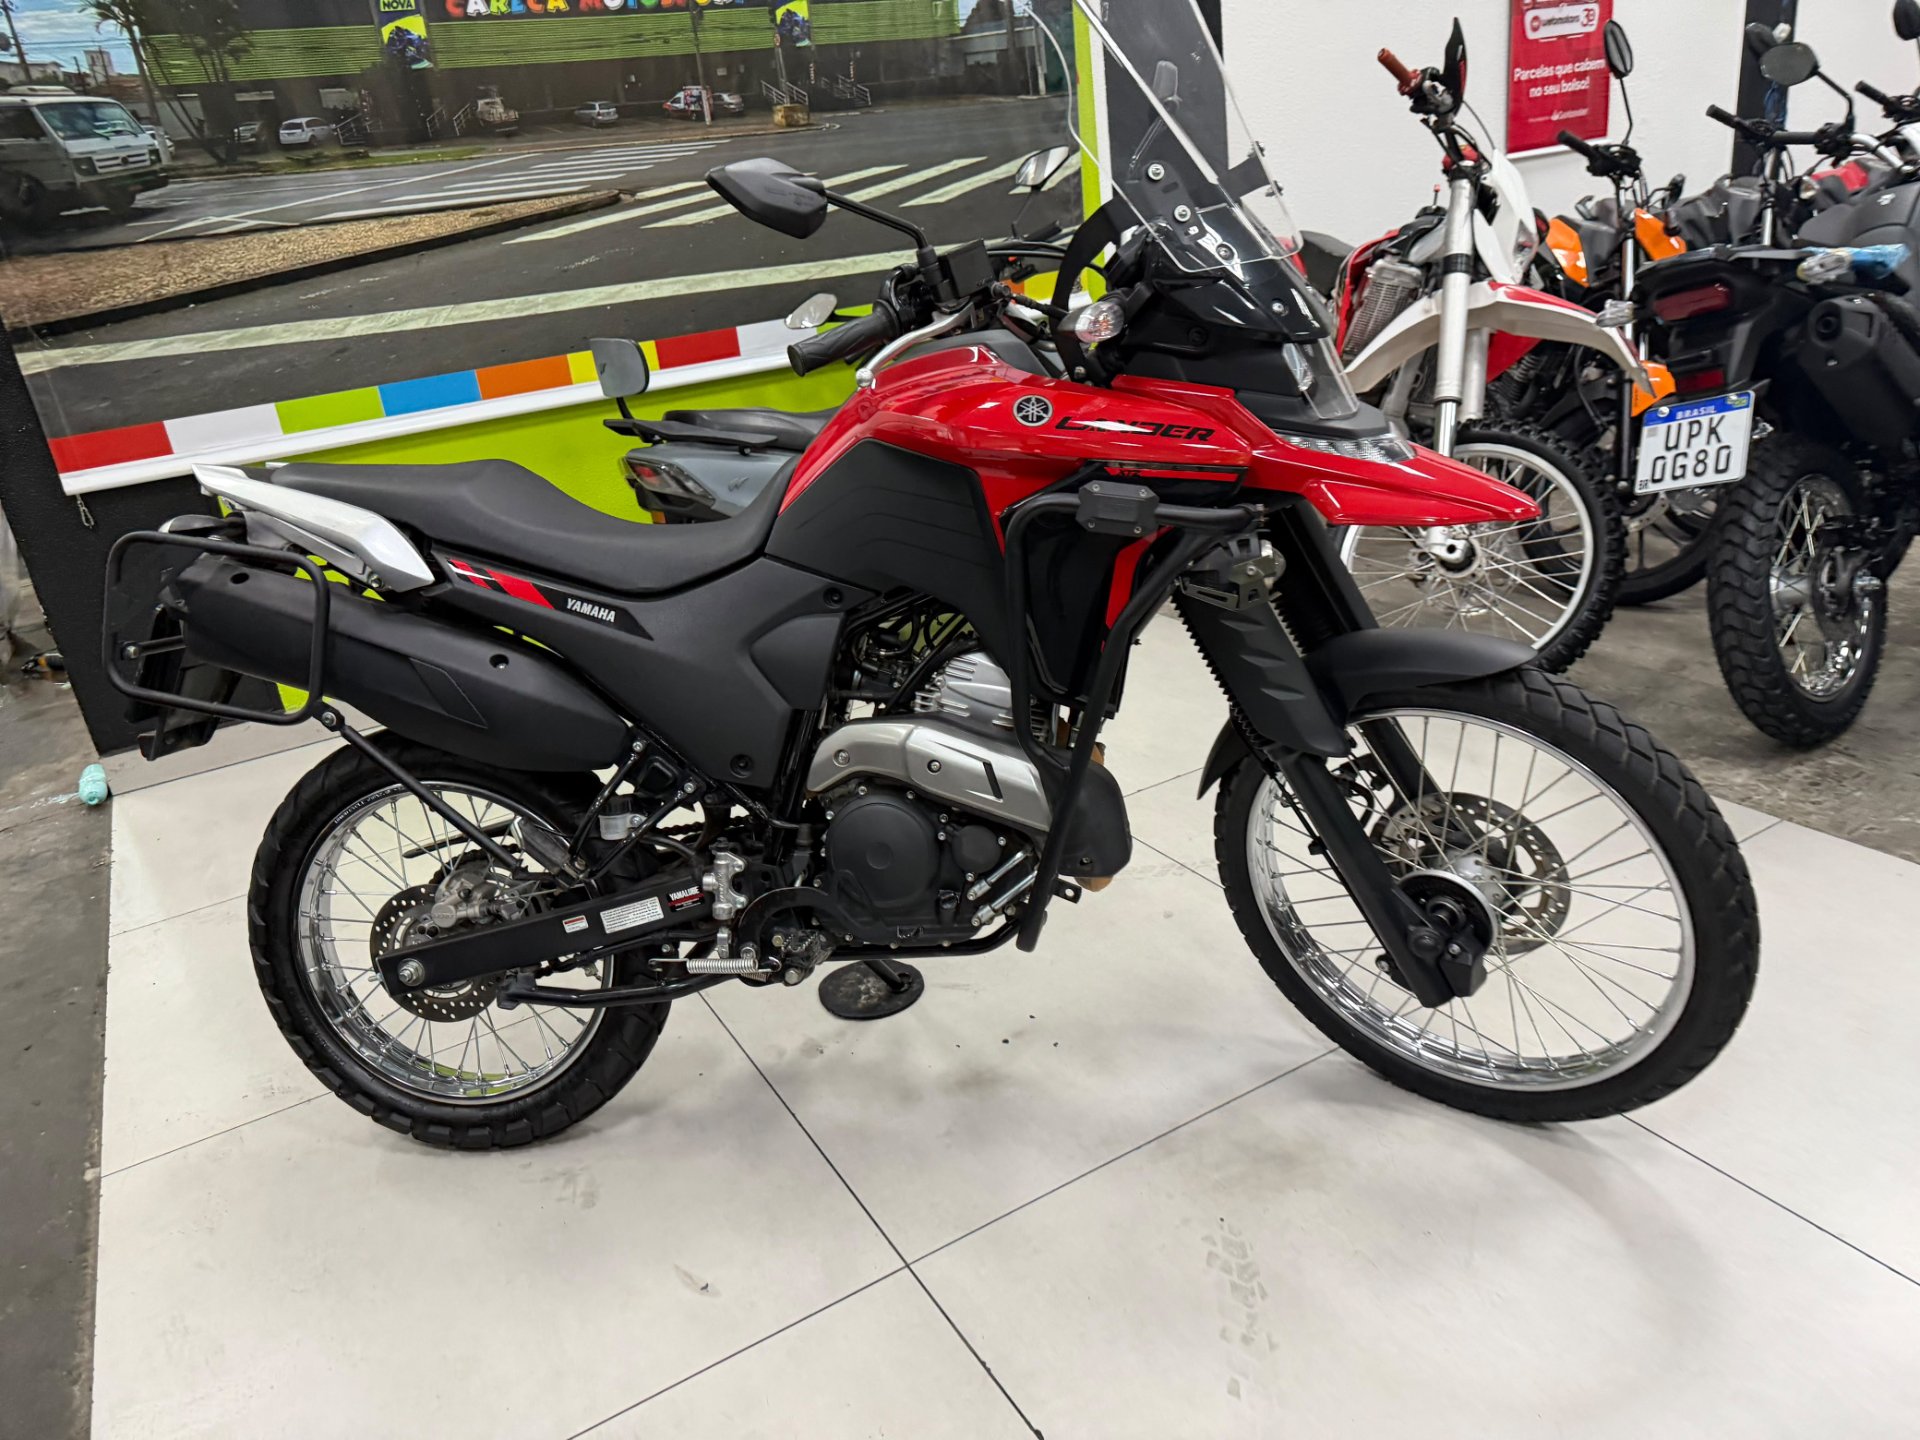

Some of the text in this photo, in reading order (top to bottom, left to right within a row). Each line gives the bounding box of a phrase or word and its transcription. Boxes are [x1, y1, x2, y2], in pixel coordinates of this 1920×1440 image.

[1514, 65, 1554, 81] Parcelas
[1555, 63, 1573, 78] que
[1529, 86, 1542, 97] no
[1543, 82, 1560, 95] seu
[1675, 405, 1717, 419] BRASIL
[1665, 415, 1725, 451] UPK
[566, 598, 616, 622] YAMAHA
